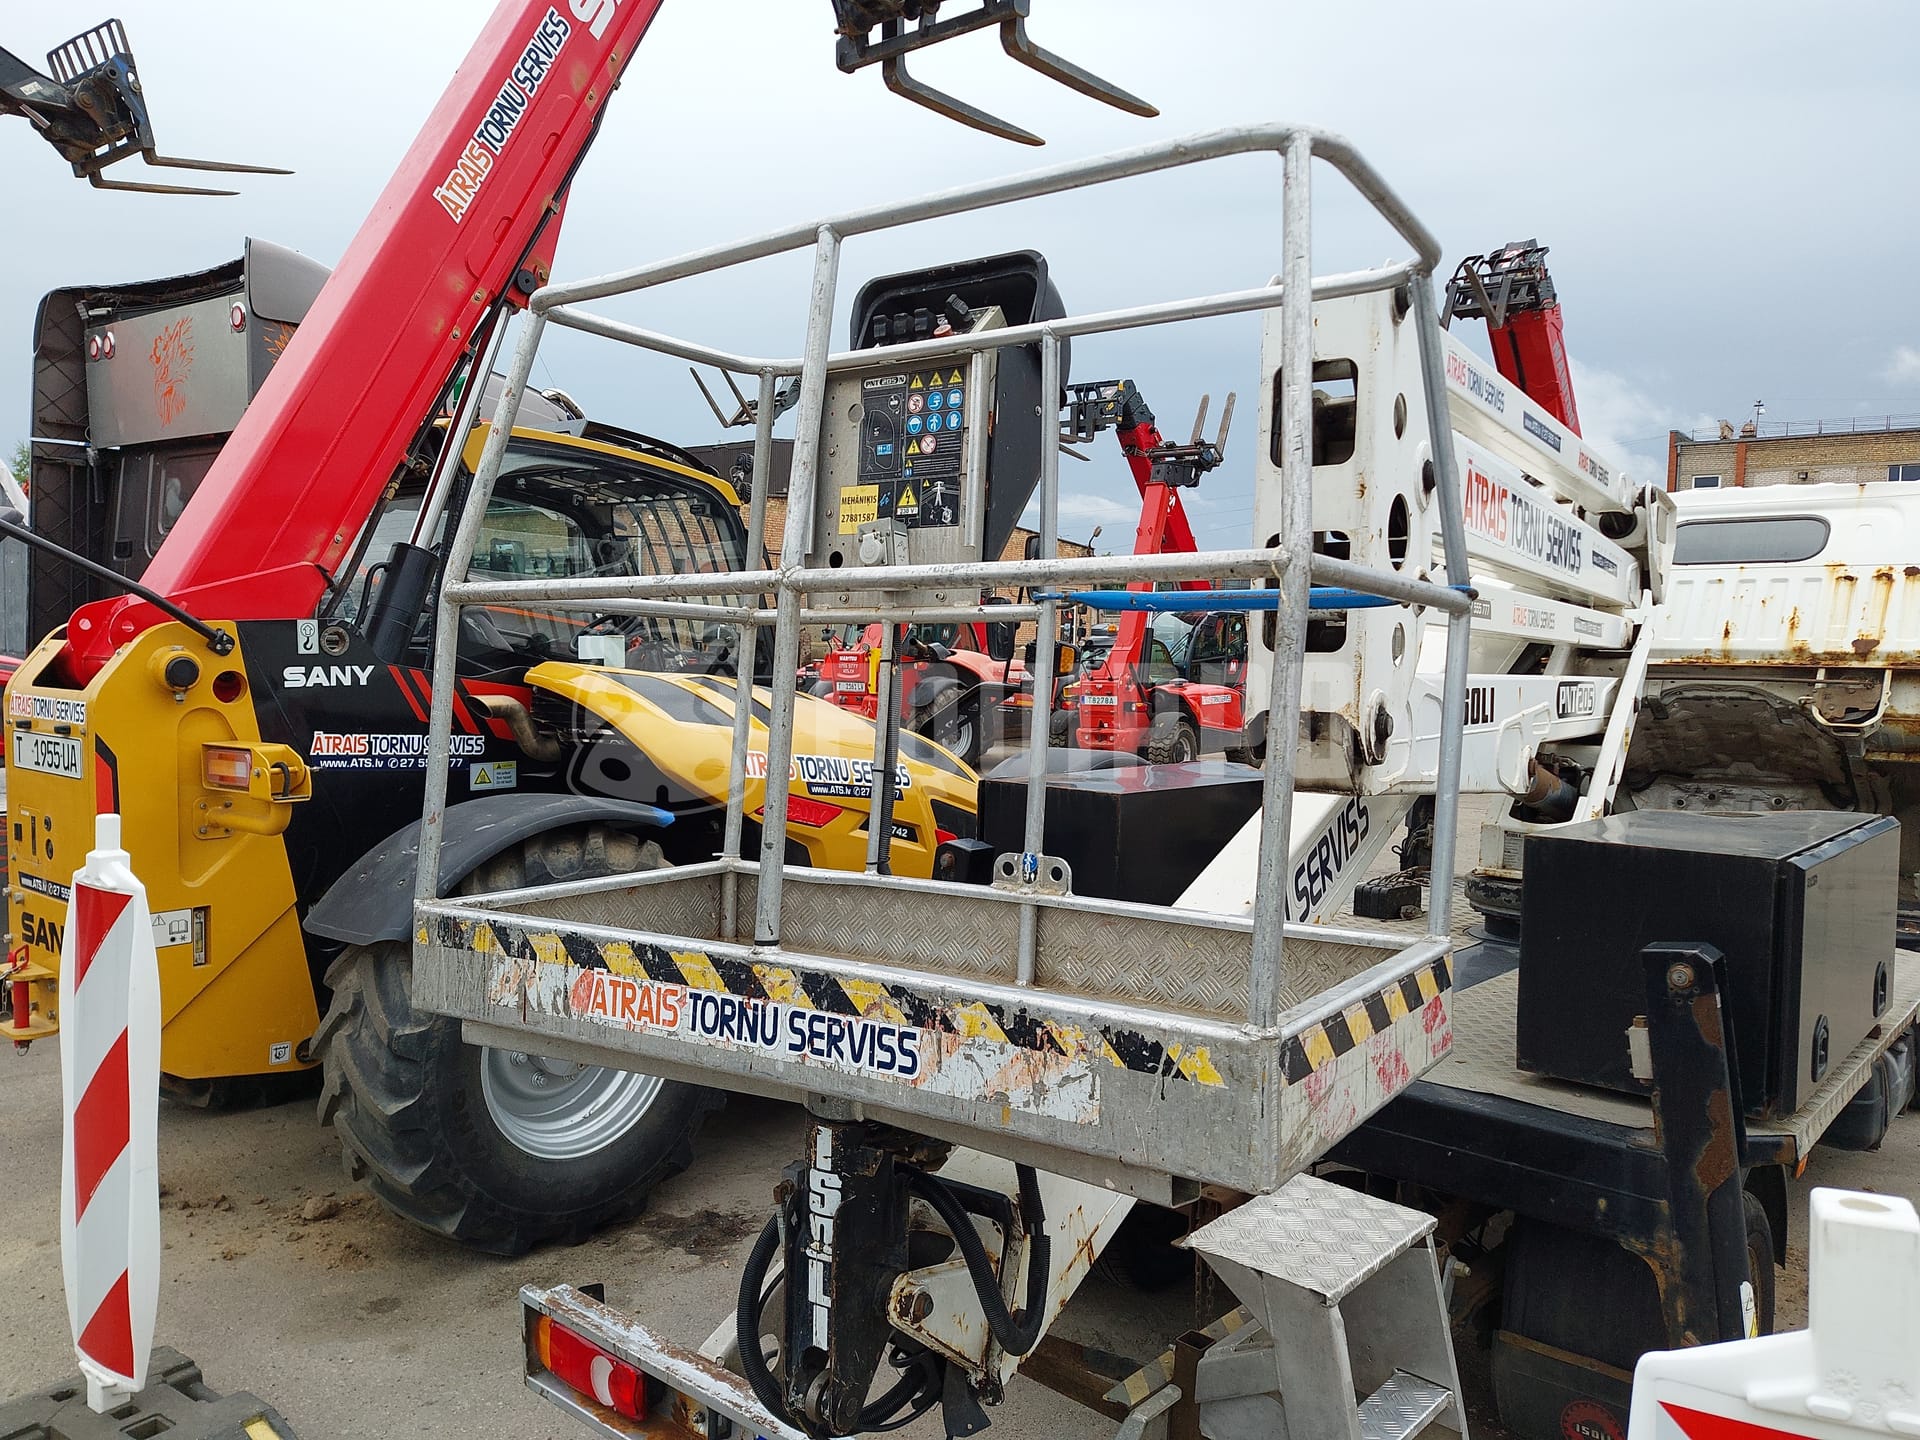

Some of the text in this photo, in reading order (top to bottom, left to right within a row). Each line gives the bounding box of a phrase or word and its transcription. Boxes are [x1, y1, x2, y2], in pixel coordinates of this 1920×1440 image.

[513, 9, 570, 95] SERVISS
[841, 513, 875, 523] 27881587
[1546, 515, 1582, 574] SERVISS
[283, 665, 375, 688] SANY
[56, 700, 85, 723] SERVISS
[16, 735, 78, 774] T 1955 UA
[313, 732, 367, 754] ĀTRAIS
[320, 757, 383, 768] www.ATS.lv
[401, 757, 413, 768] 27
[810, 785, 870, 797] www.ATS.lv 27
[1294, 797, 1370, 923] SERVISS
[22, 911, 65, 956] SAN
[590, 970, 679, 1028] ĀTRAIS
[787, 1010, 918, 1076] SERVISS
